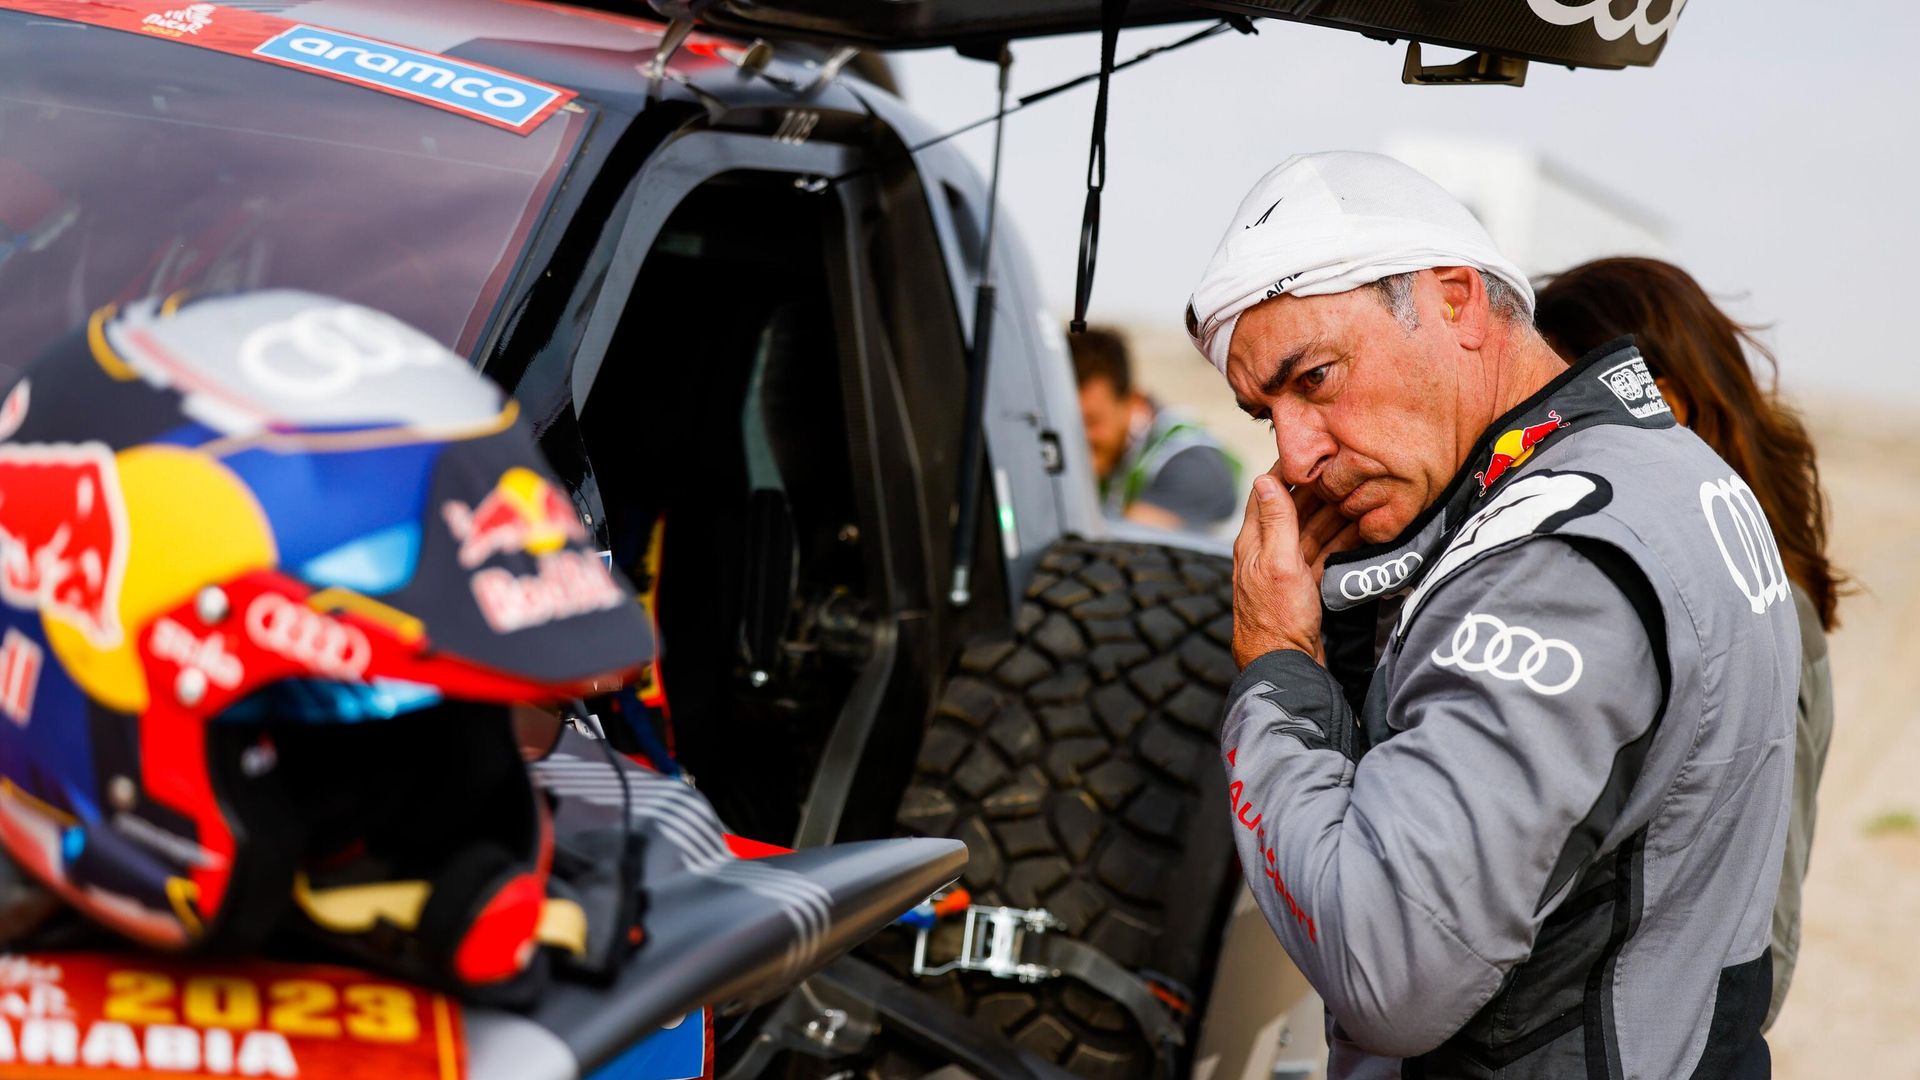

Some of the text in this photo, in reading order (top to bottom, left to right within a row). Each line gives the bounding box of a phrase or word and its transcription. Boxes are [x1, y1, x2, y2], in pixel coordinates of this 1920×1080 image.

[289, 37, 527, 108] aramco
[104, 969, 420, 1043] 2023
[0, 1017, 299, 1079] RABIA
